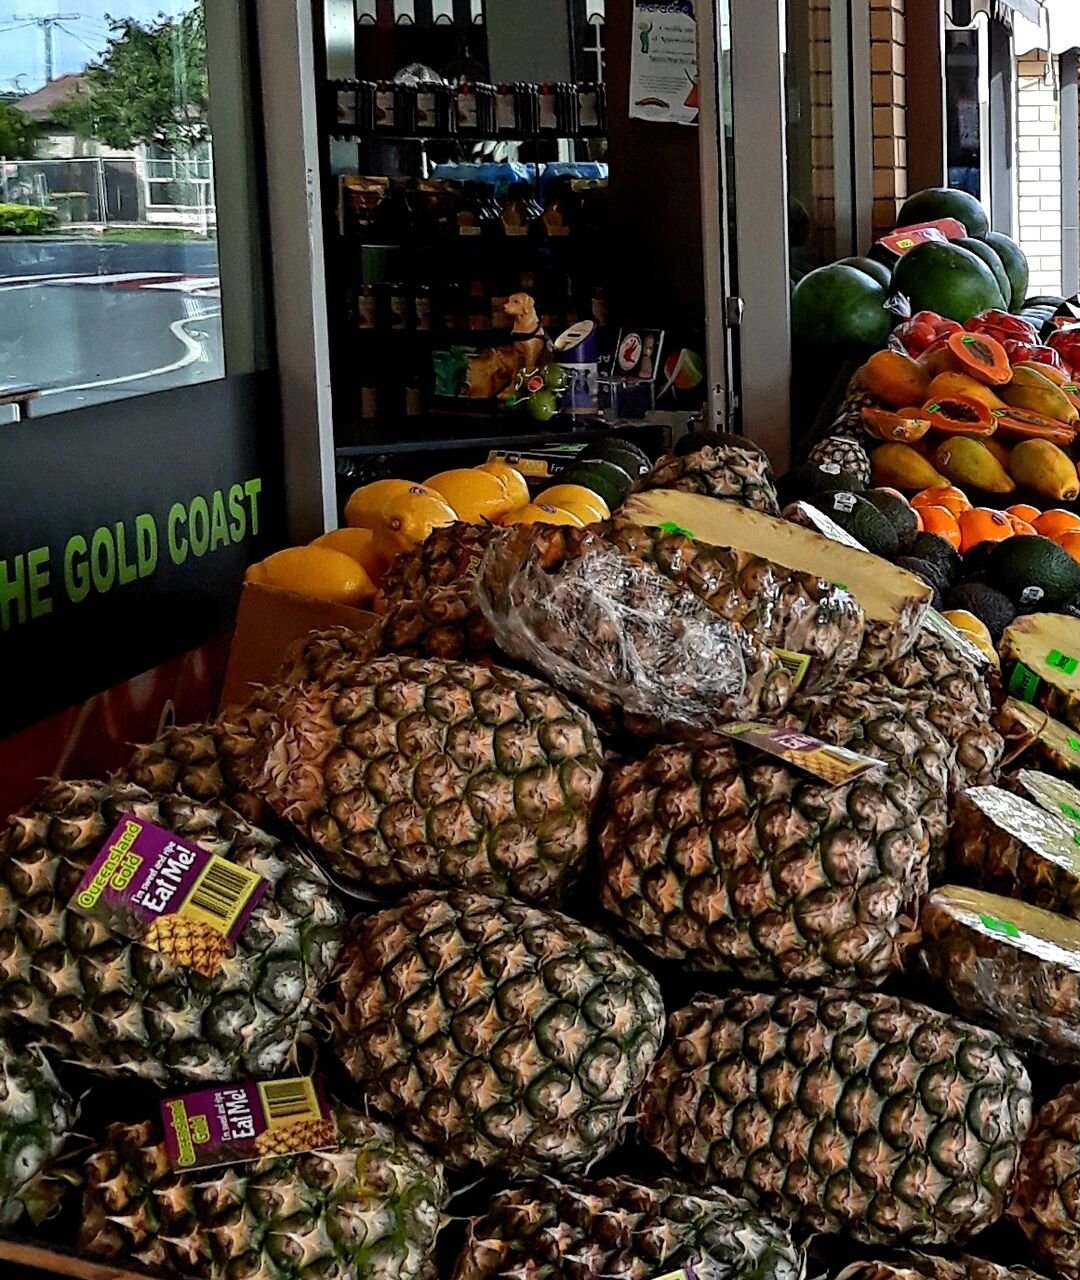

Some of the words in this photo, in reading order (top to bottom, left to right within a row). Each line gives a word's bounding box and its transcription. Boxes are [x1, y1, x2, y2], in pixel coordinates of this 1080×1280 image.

[0, 546, 53, 631] HE
[64, 513, 158, 603] GOLD
[168, 477, 262, 565] COAST
[78, 821, 142, 908] Queensland
[110, 853, 143, 891] Gold
[131, 891, 144, 904] I'm
[140, 867, 157, 892] sweet
[153, 855, 167, 869] and
[162, 841, 177, 860] ripe
[142, 878, 178, 913] Eat
[164, 845, 197, 883] Me!
[223, 1088, 250, 1114] Me!
[230, 1114, 255, 1139] Eat
